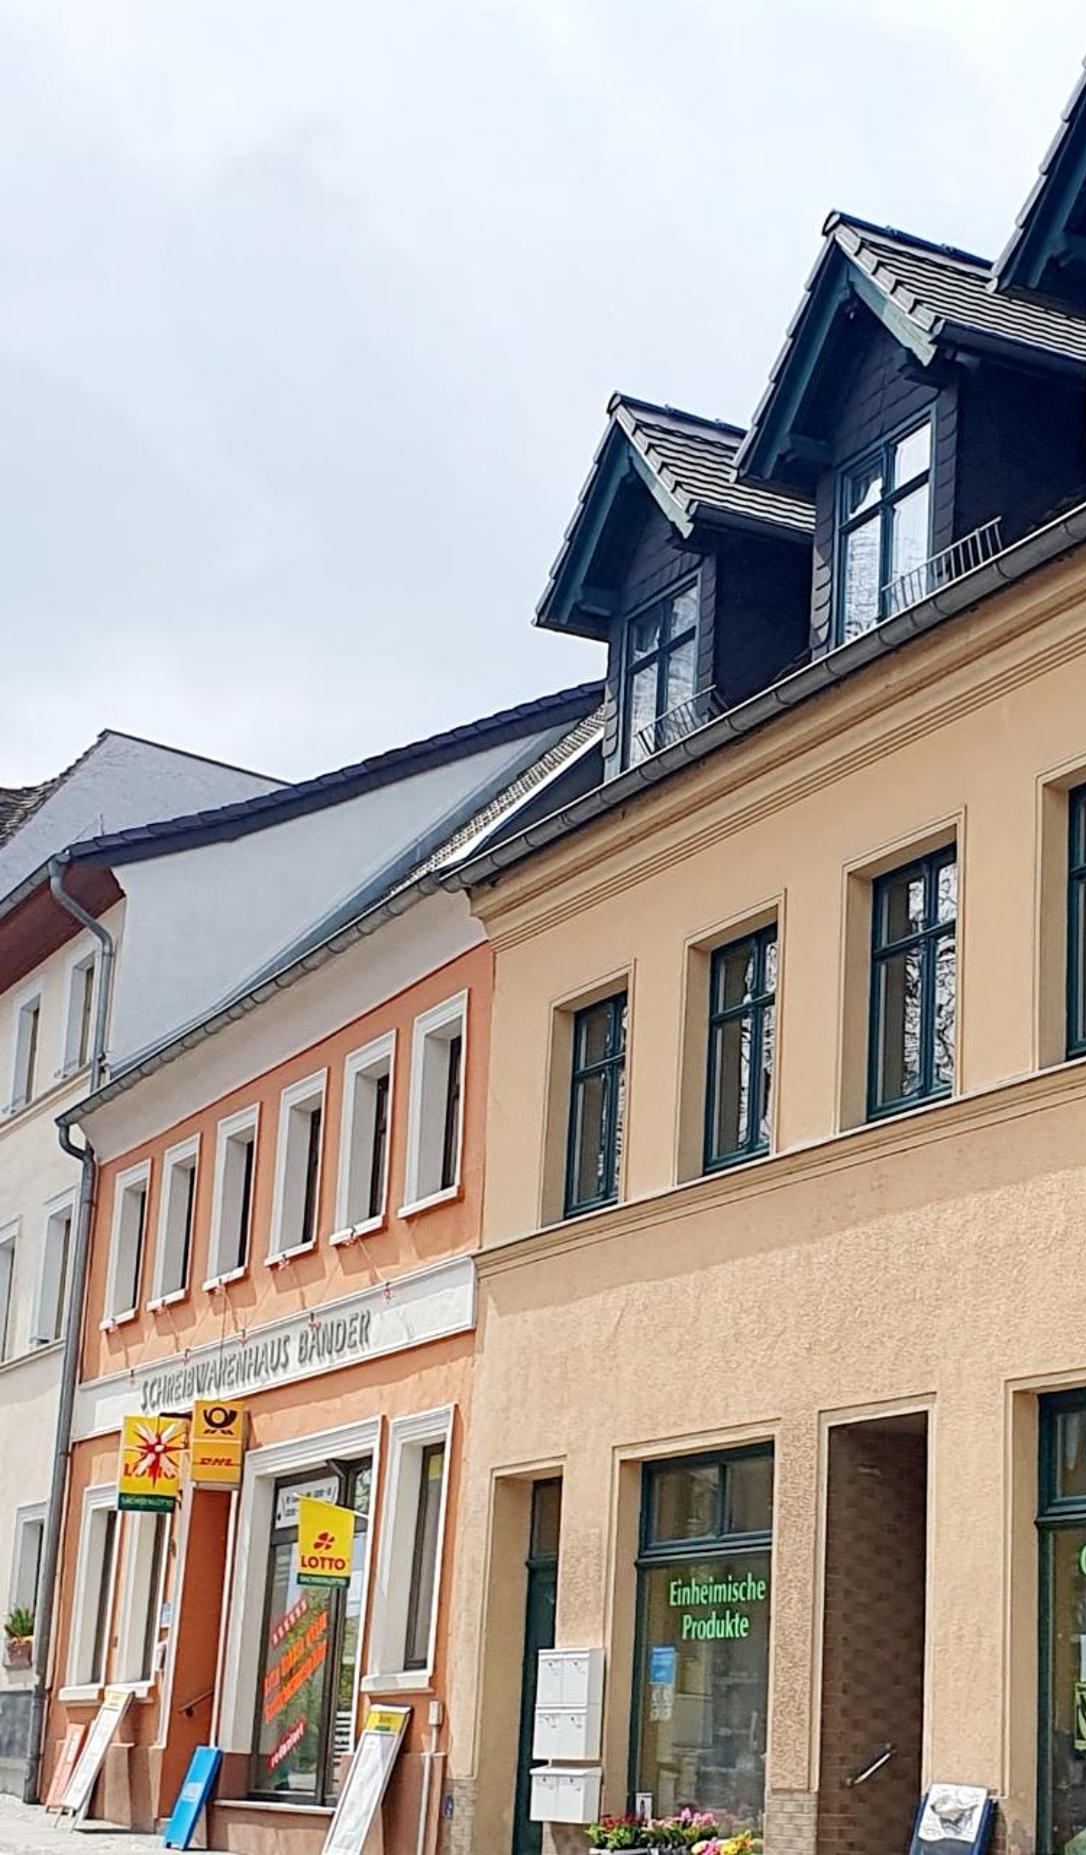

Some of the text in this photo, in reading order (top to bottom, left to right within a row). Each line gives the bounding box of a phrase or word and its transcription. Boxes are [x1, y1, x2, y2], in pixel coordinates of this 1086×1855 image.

[140, 1334, 291, 1411] SCHREIBWARENHAUS
[199, 1457, 233, 1467] DHL
[300, 1555, 346, 1571] LOTTO
[669, 1572, 767, 1606] Einheimische
[682, 1610, 750, 1639] Produkte
